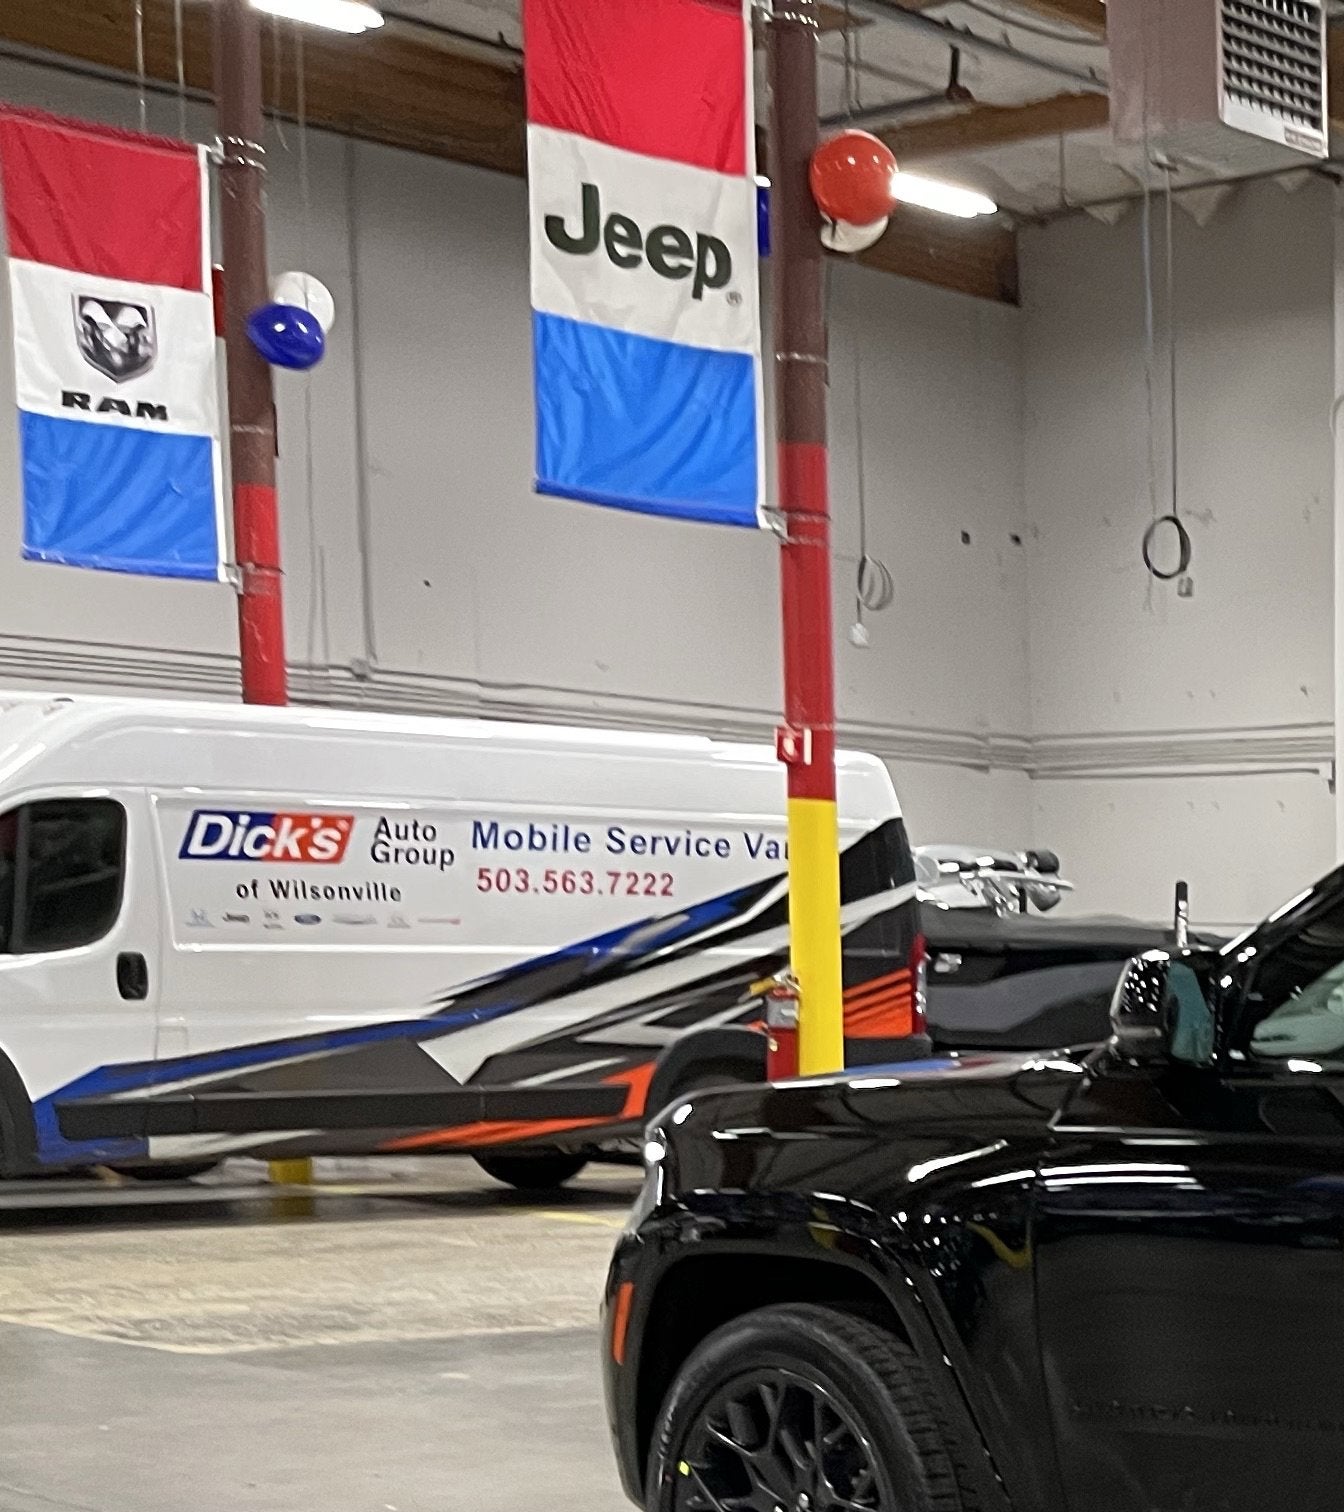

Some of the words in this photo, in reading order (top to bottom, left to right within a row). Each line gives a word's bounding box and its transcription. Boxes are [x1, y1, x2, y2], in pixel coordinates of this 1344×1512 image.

[545, 182, 732, 302] Jeep
[62, 390, 169, 422] RAM
[374, 816, 438, 842] Auto
[472, 820, 592, 852] Mobile
[606, 825, 731, 859] Service
[744, 832, 789, 860] Va
[371, 841, 455, 871] Group
[236, 879, 259, 899] of
[269, 879, 402, 902] Wilsonville
[477, 868, 675, 897] 503.563.7222
